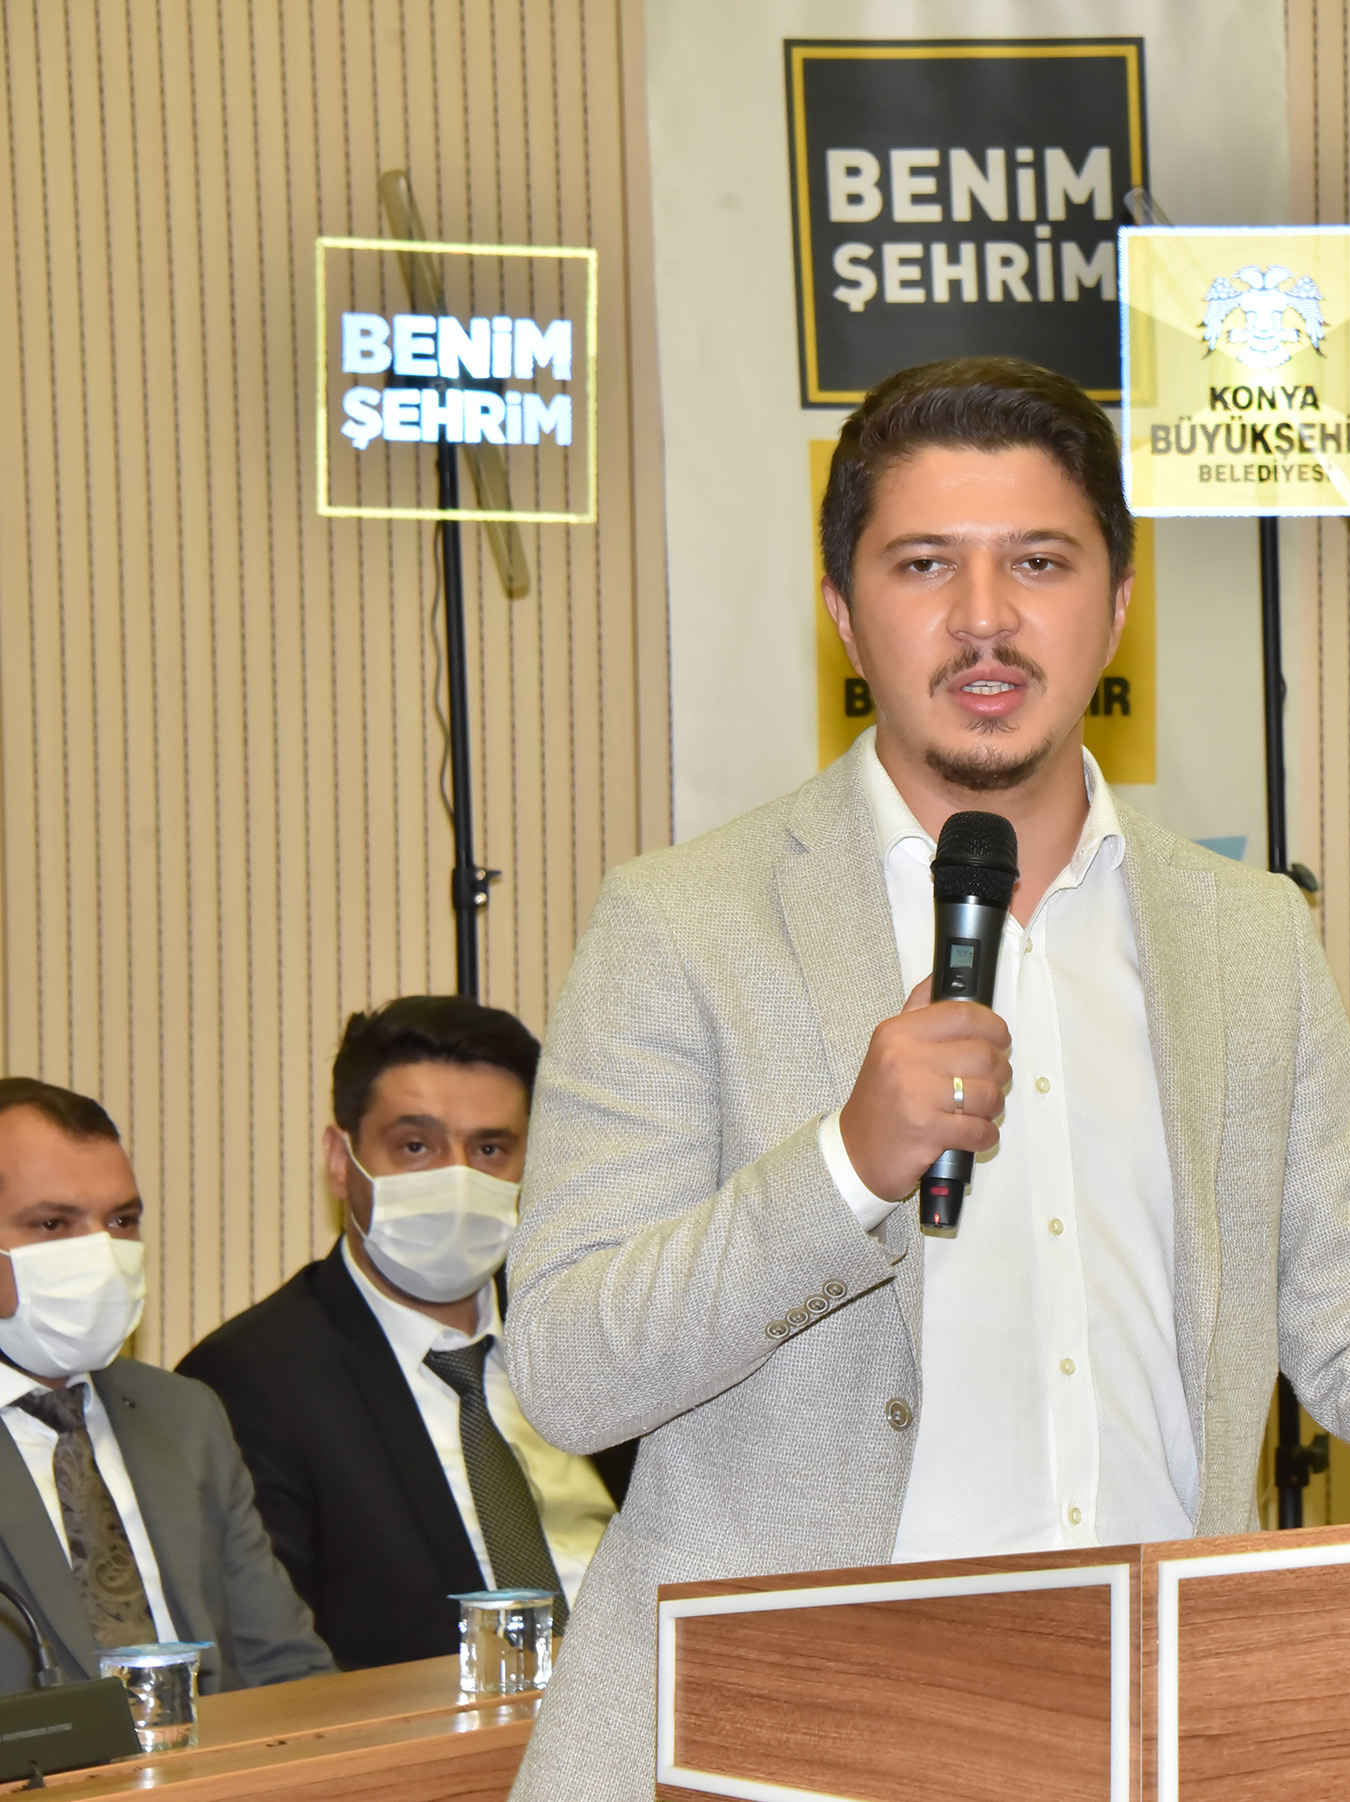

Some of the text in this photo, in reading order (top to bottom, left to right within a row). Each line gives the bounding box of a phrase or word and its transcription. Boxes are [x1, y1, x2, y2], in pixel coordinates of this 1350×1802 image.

[832, 224, 1117, 312] ŞEHRİM
[1209, 385, 1320, 411] KONYA
[1198, 459, 1334, 483] BELEDİYES
